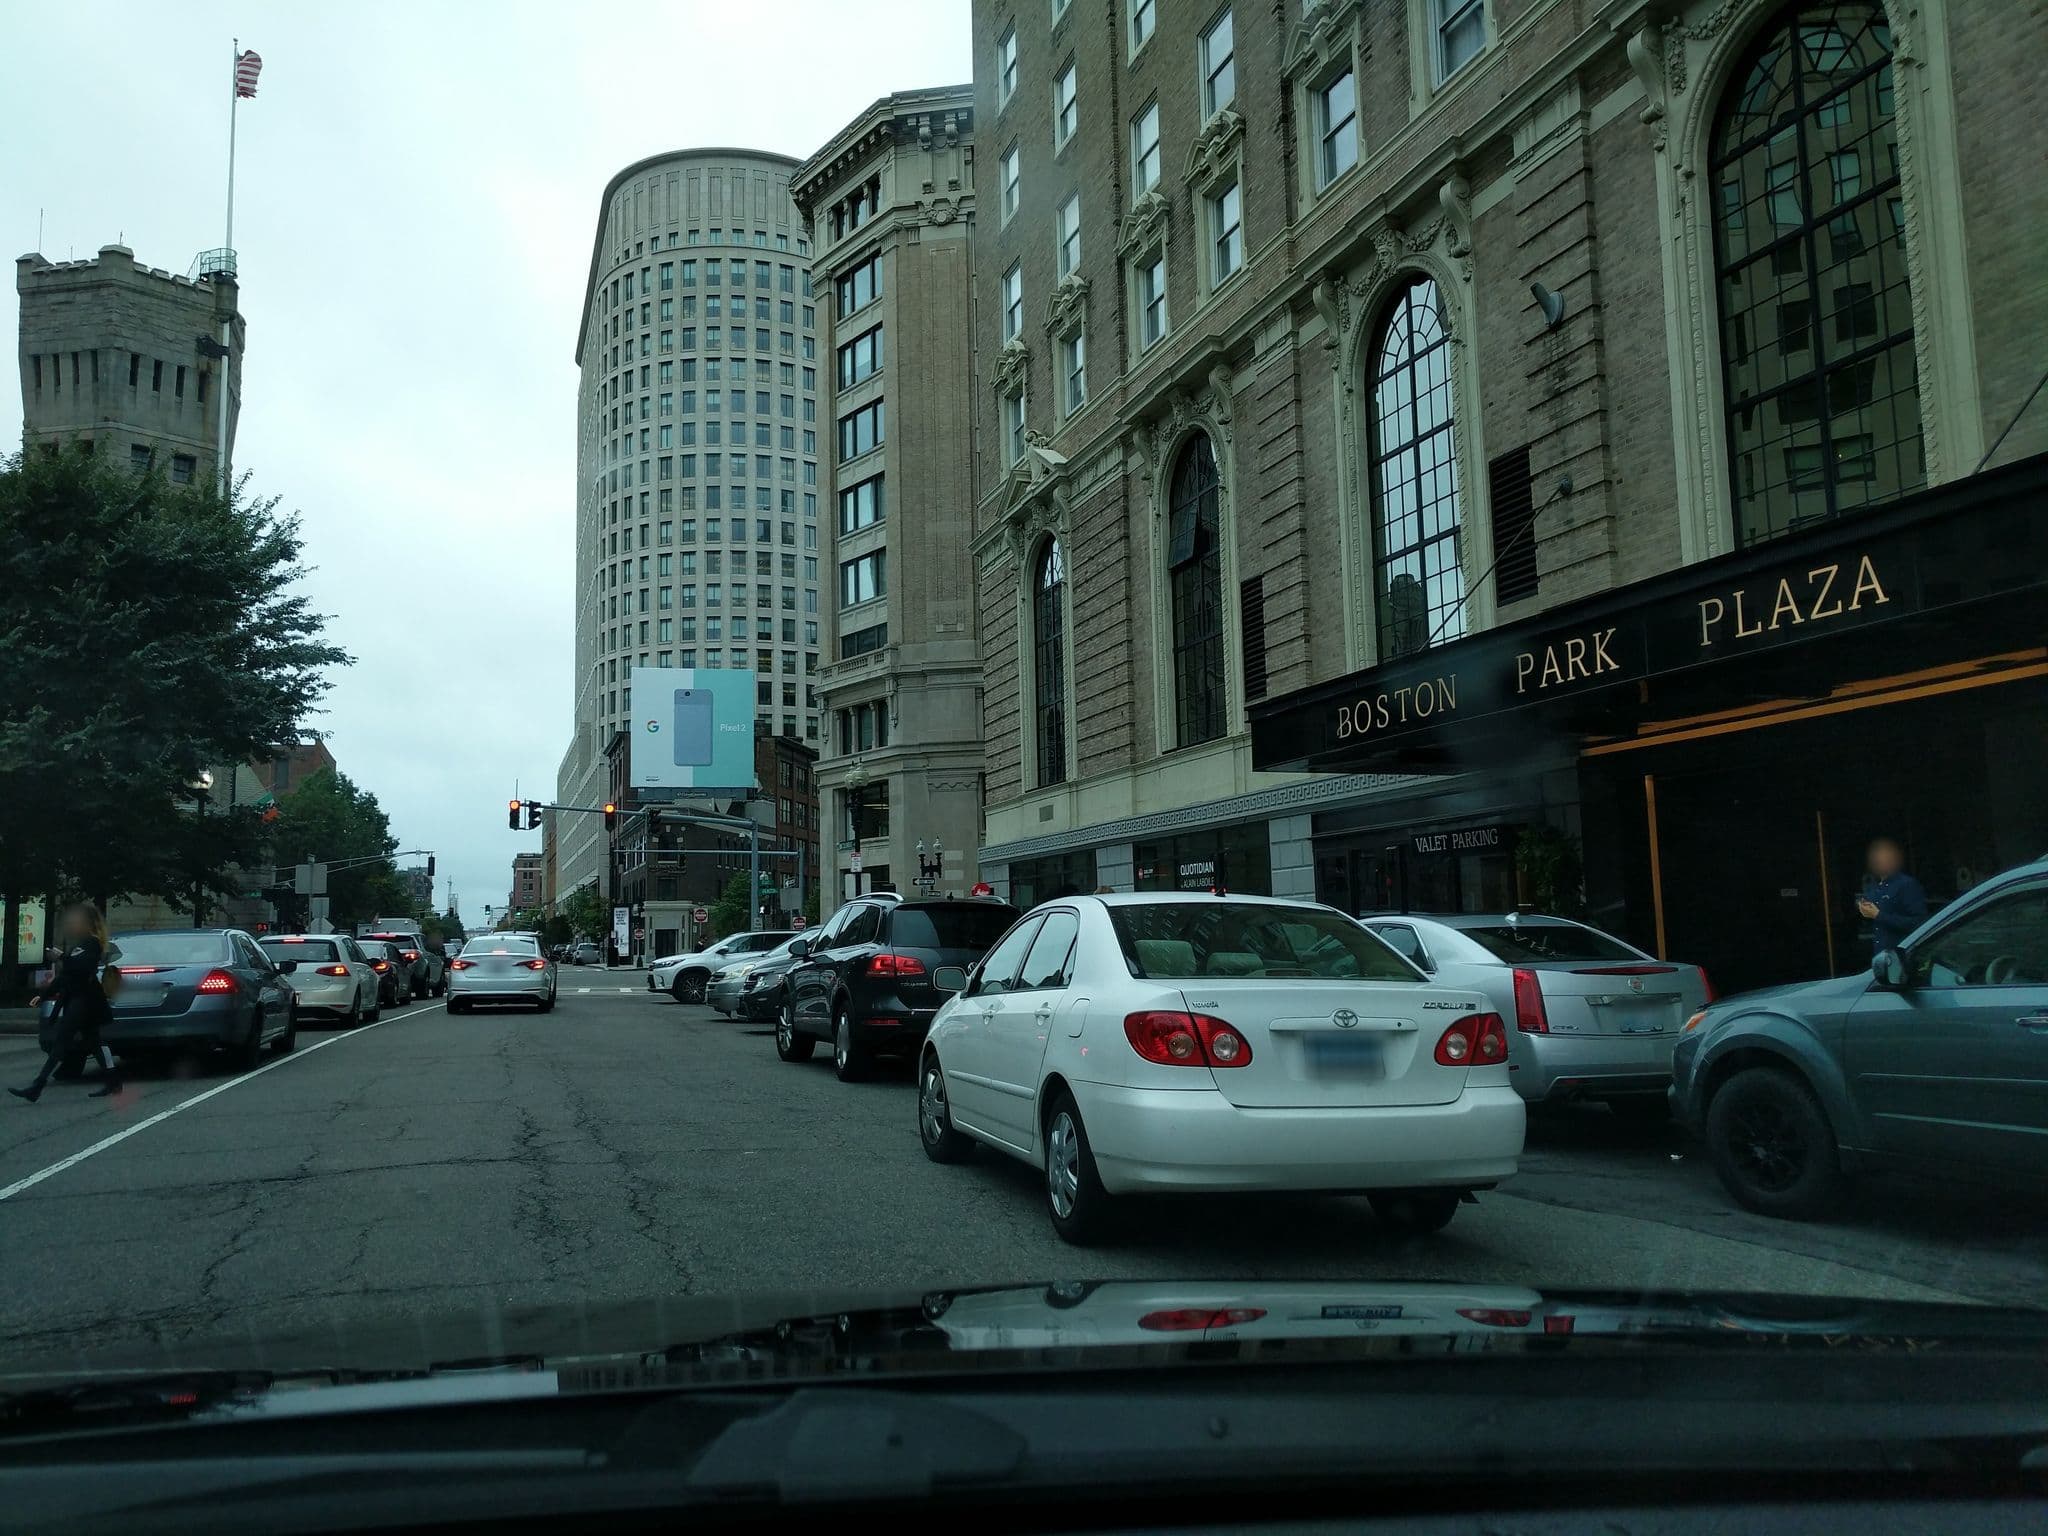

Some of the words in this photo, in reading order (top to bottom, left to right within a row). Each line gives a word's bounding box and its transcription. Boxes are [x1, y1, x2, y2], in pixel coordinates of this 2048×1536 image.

[1336, 673, 1457, 739] BOSTON
[1515, 628, 1620, 694] PARK
[1698, 555, 1890, 646] PLAZA
[720, 723, 740, 732] Pixel
[740, 724, 747, 732] 2
[1415, 834, 1448, 853] VALET
[1451, 828, 1499, 849] PARKING
[1180, 861, 1214, 876] QUOTIDIAN
[1422, 1001, 1464, 1010] COROLLA
